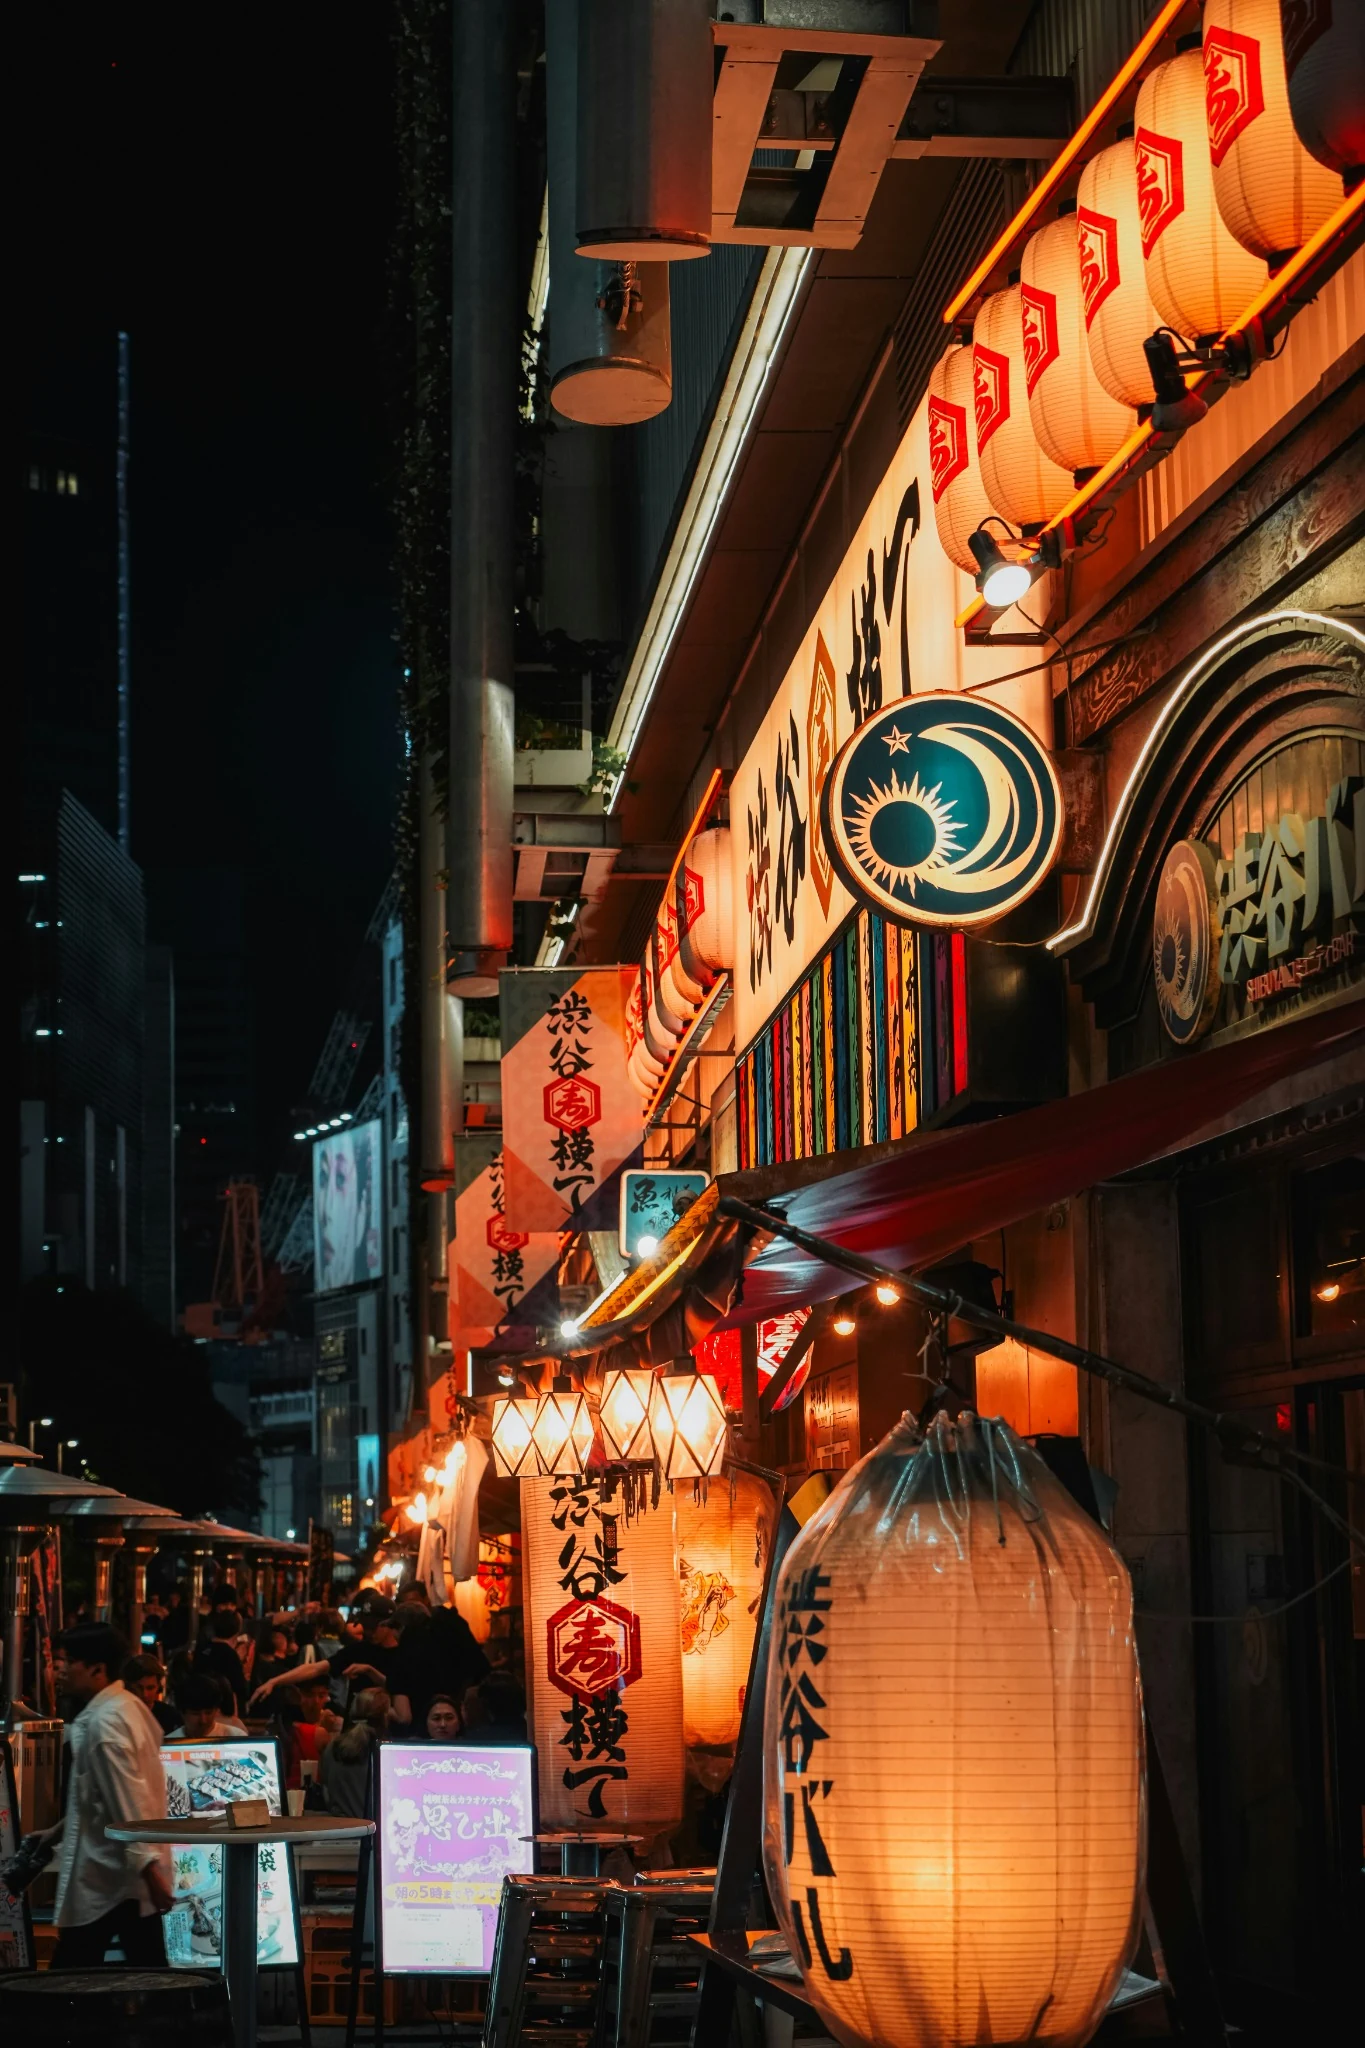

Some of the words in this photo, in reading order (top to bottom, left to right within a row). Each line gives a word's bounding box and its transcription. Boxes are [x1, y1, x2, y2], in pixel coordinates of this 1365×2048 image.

[422, 1804, 513, 1840] 思ひ出
[395, 1886, 499, 1901] 朝の5時までやって
